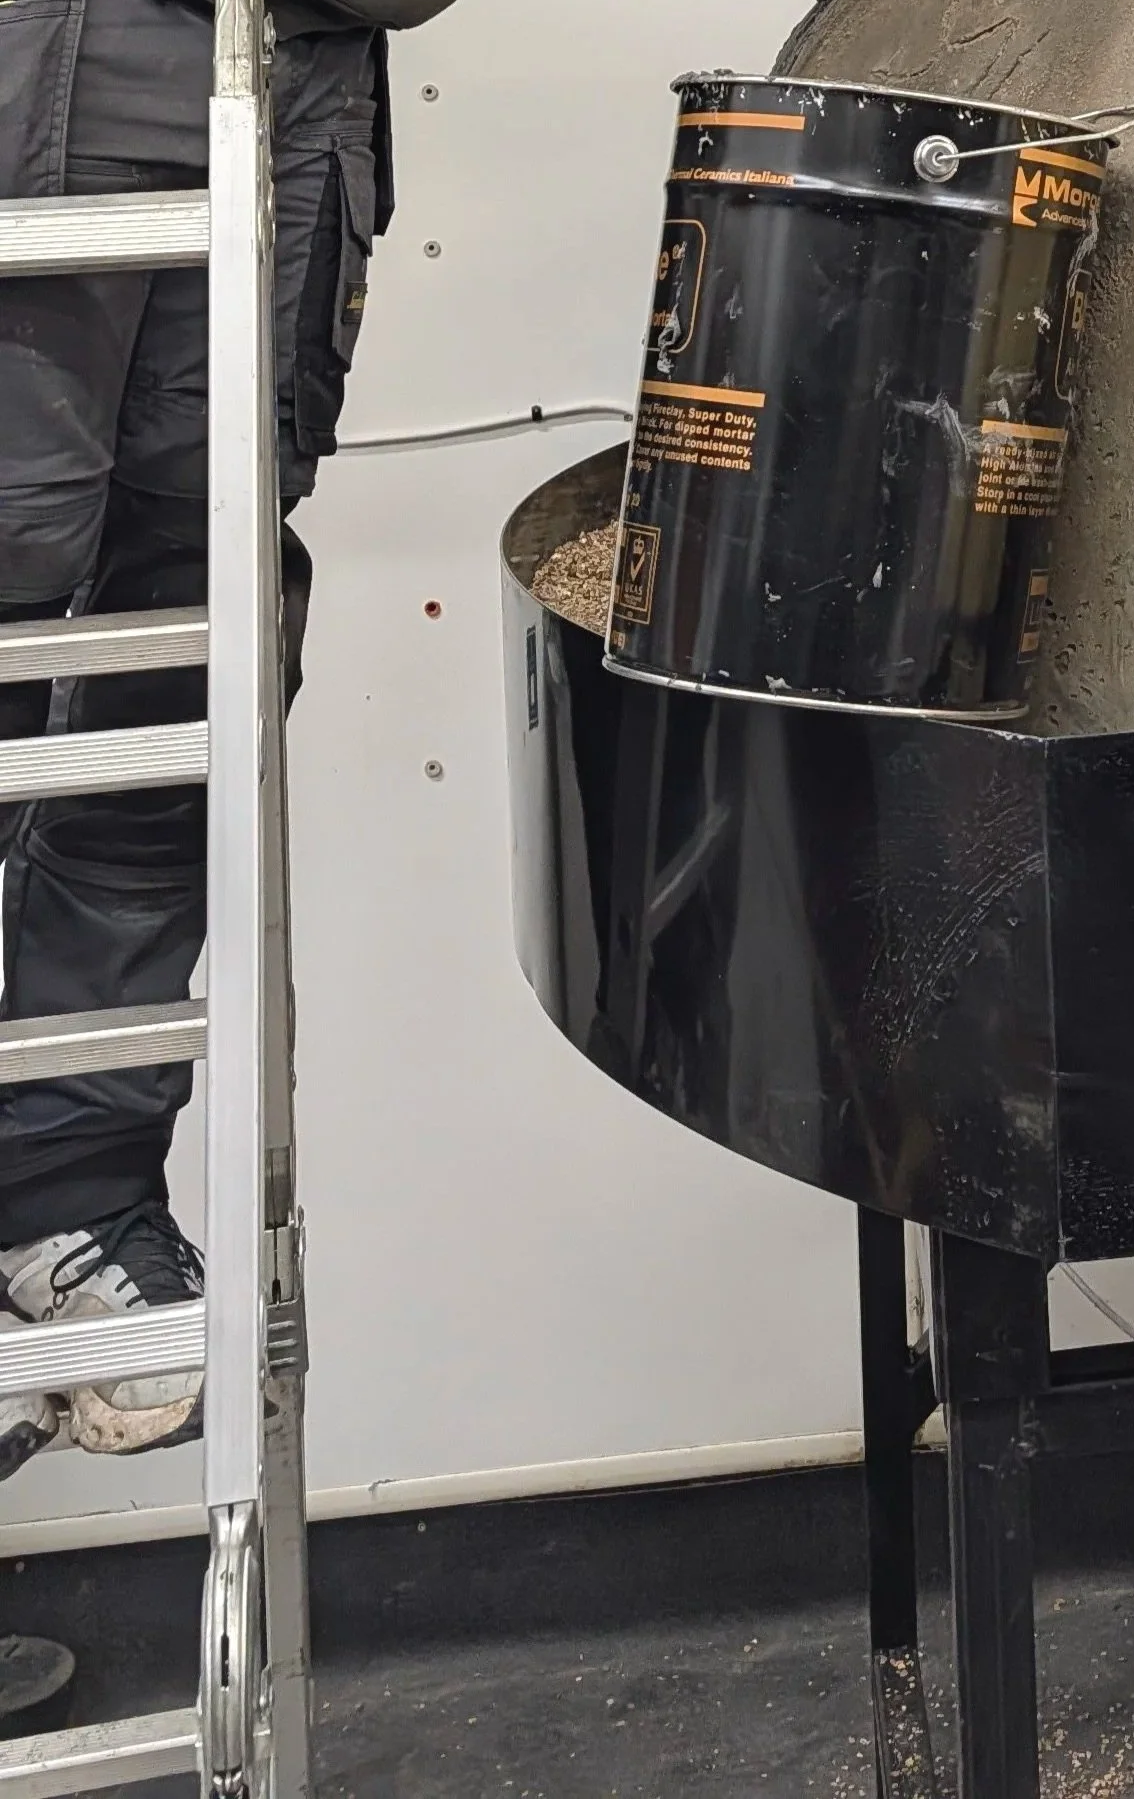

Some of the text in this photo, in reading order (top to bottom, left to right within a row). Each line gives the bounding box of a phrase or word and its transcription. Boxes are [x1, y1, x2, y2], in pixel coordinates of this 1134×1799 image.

[693, 168, 741, 181] Ceramics
[743, 169, 795, 185] Italiana
[653, 403, 685, 420] Fireclay,
[688, 407, 721, 422] Super
[725, 411, 757, 428] Duty,
[658, 418, 673, 430] For
[675, 421, 710, 436] dipped
[713, 427, 756, 441] mortar
[654, 433, 682, 446] desired
[684, 438, 753, 457] consistency.
[665, 450, 698, 464] unused
[701, 455, 751, 471] contents
[981, 457, 1006, 471] High
[978, 471, 1002, 485] joint
[1007, 489, 1015, 500] in
[975, 502, 998, 514] with
[1000, 505, 1007, 514] a
[1009, 503, 1027, 515] thin
